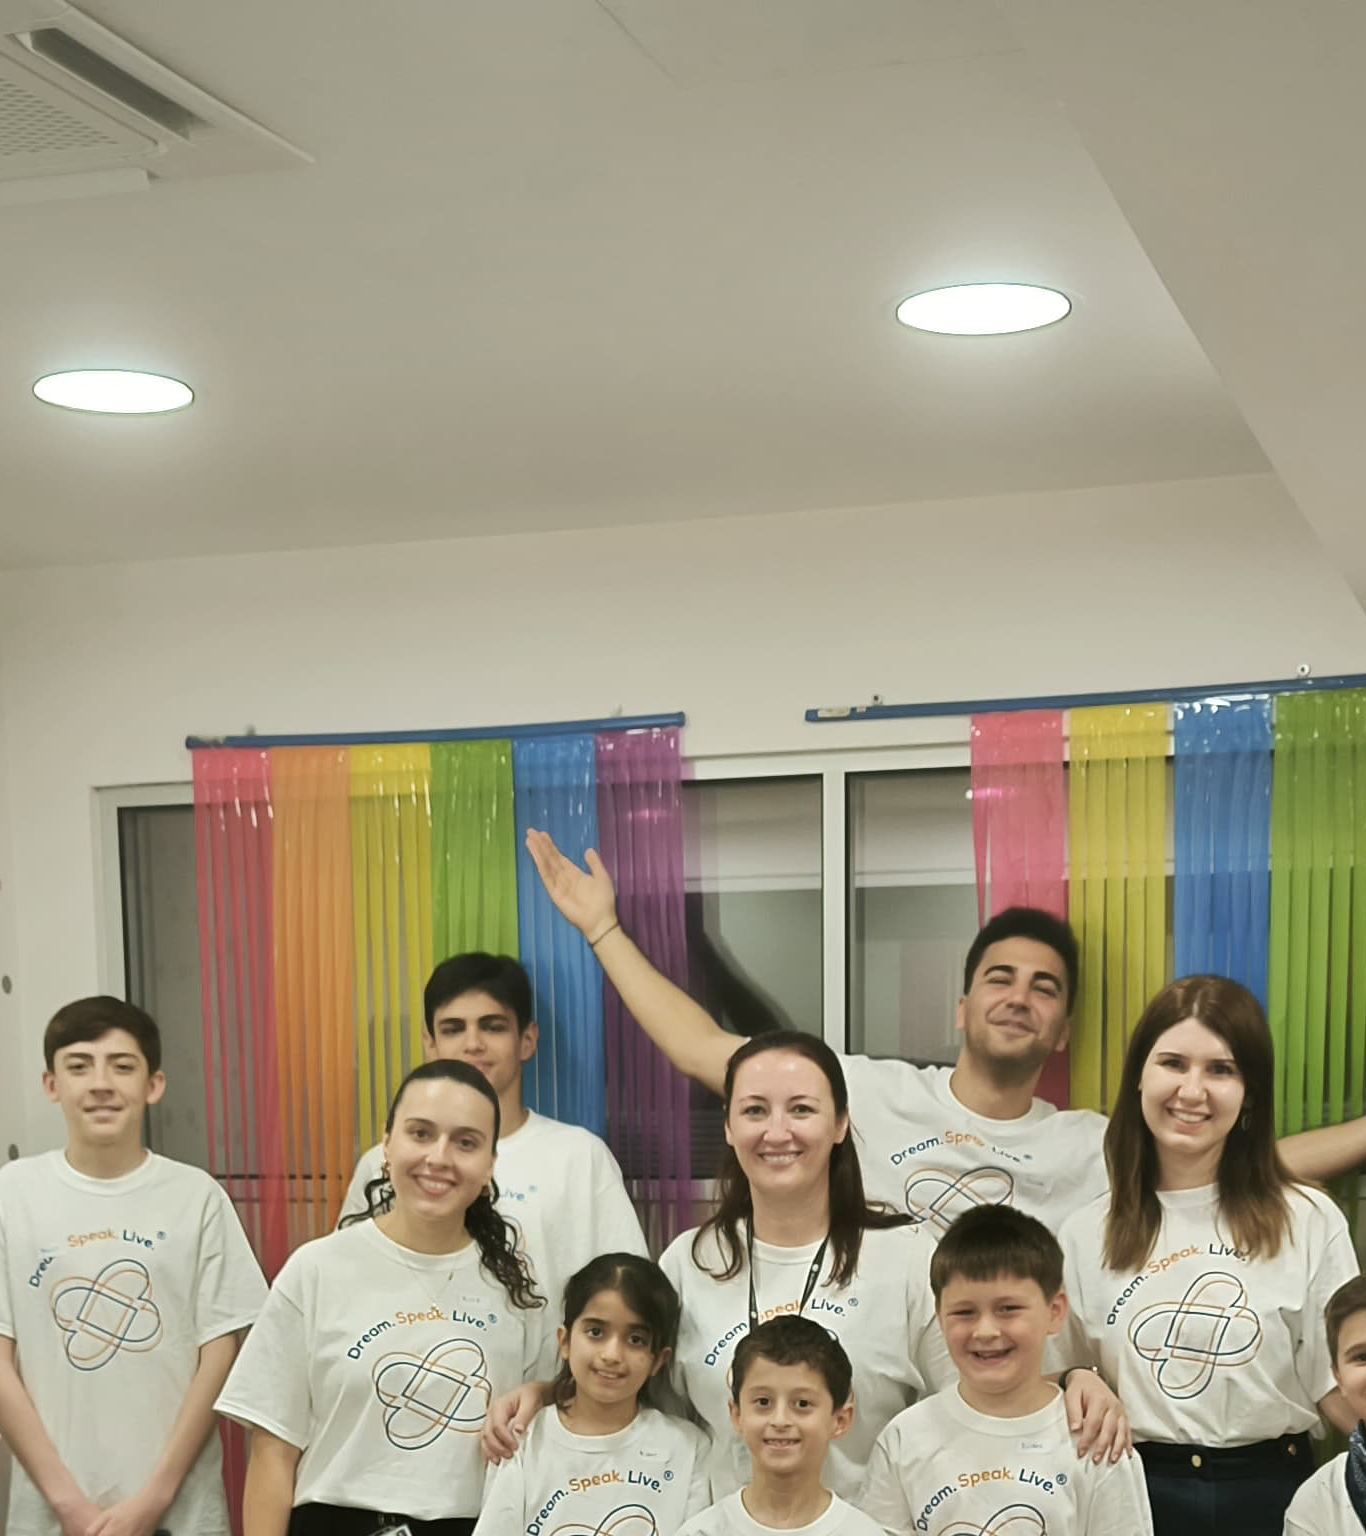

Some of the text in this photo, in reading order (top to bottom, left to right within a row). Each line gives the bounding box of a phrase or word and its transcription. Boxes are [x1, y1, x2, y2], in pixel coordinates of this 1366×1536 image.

[890, 1136, 944, 1165] Dream.
[1107, 1275, 1149, 1325] Dream.
[347, 1319, 396, 1360] Dream.
[526, 1488, 569, 1536] Dream.
[916, 1484, 958, 1532] Dream.
[958, 1466, 1015, 1488] Speak.
